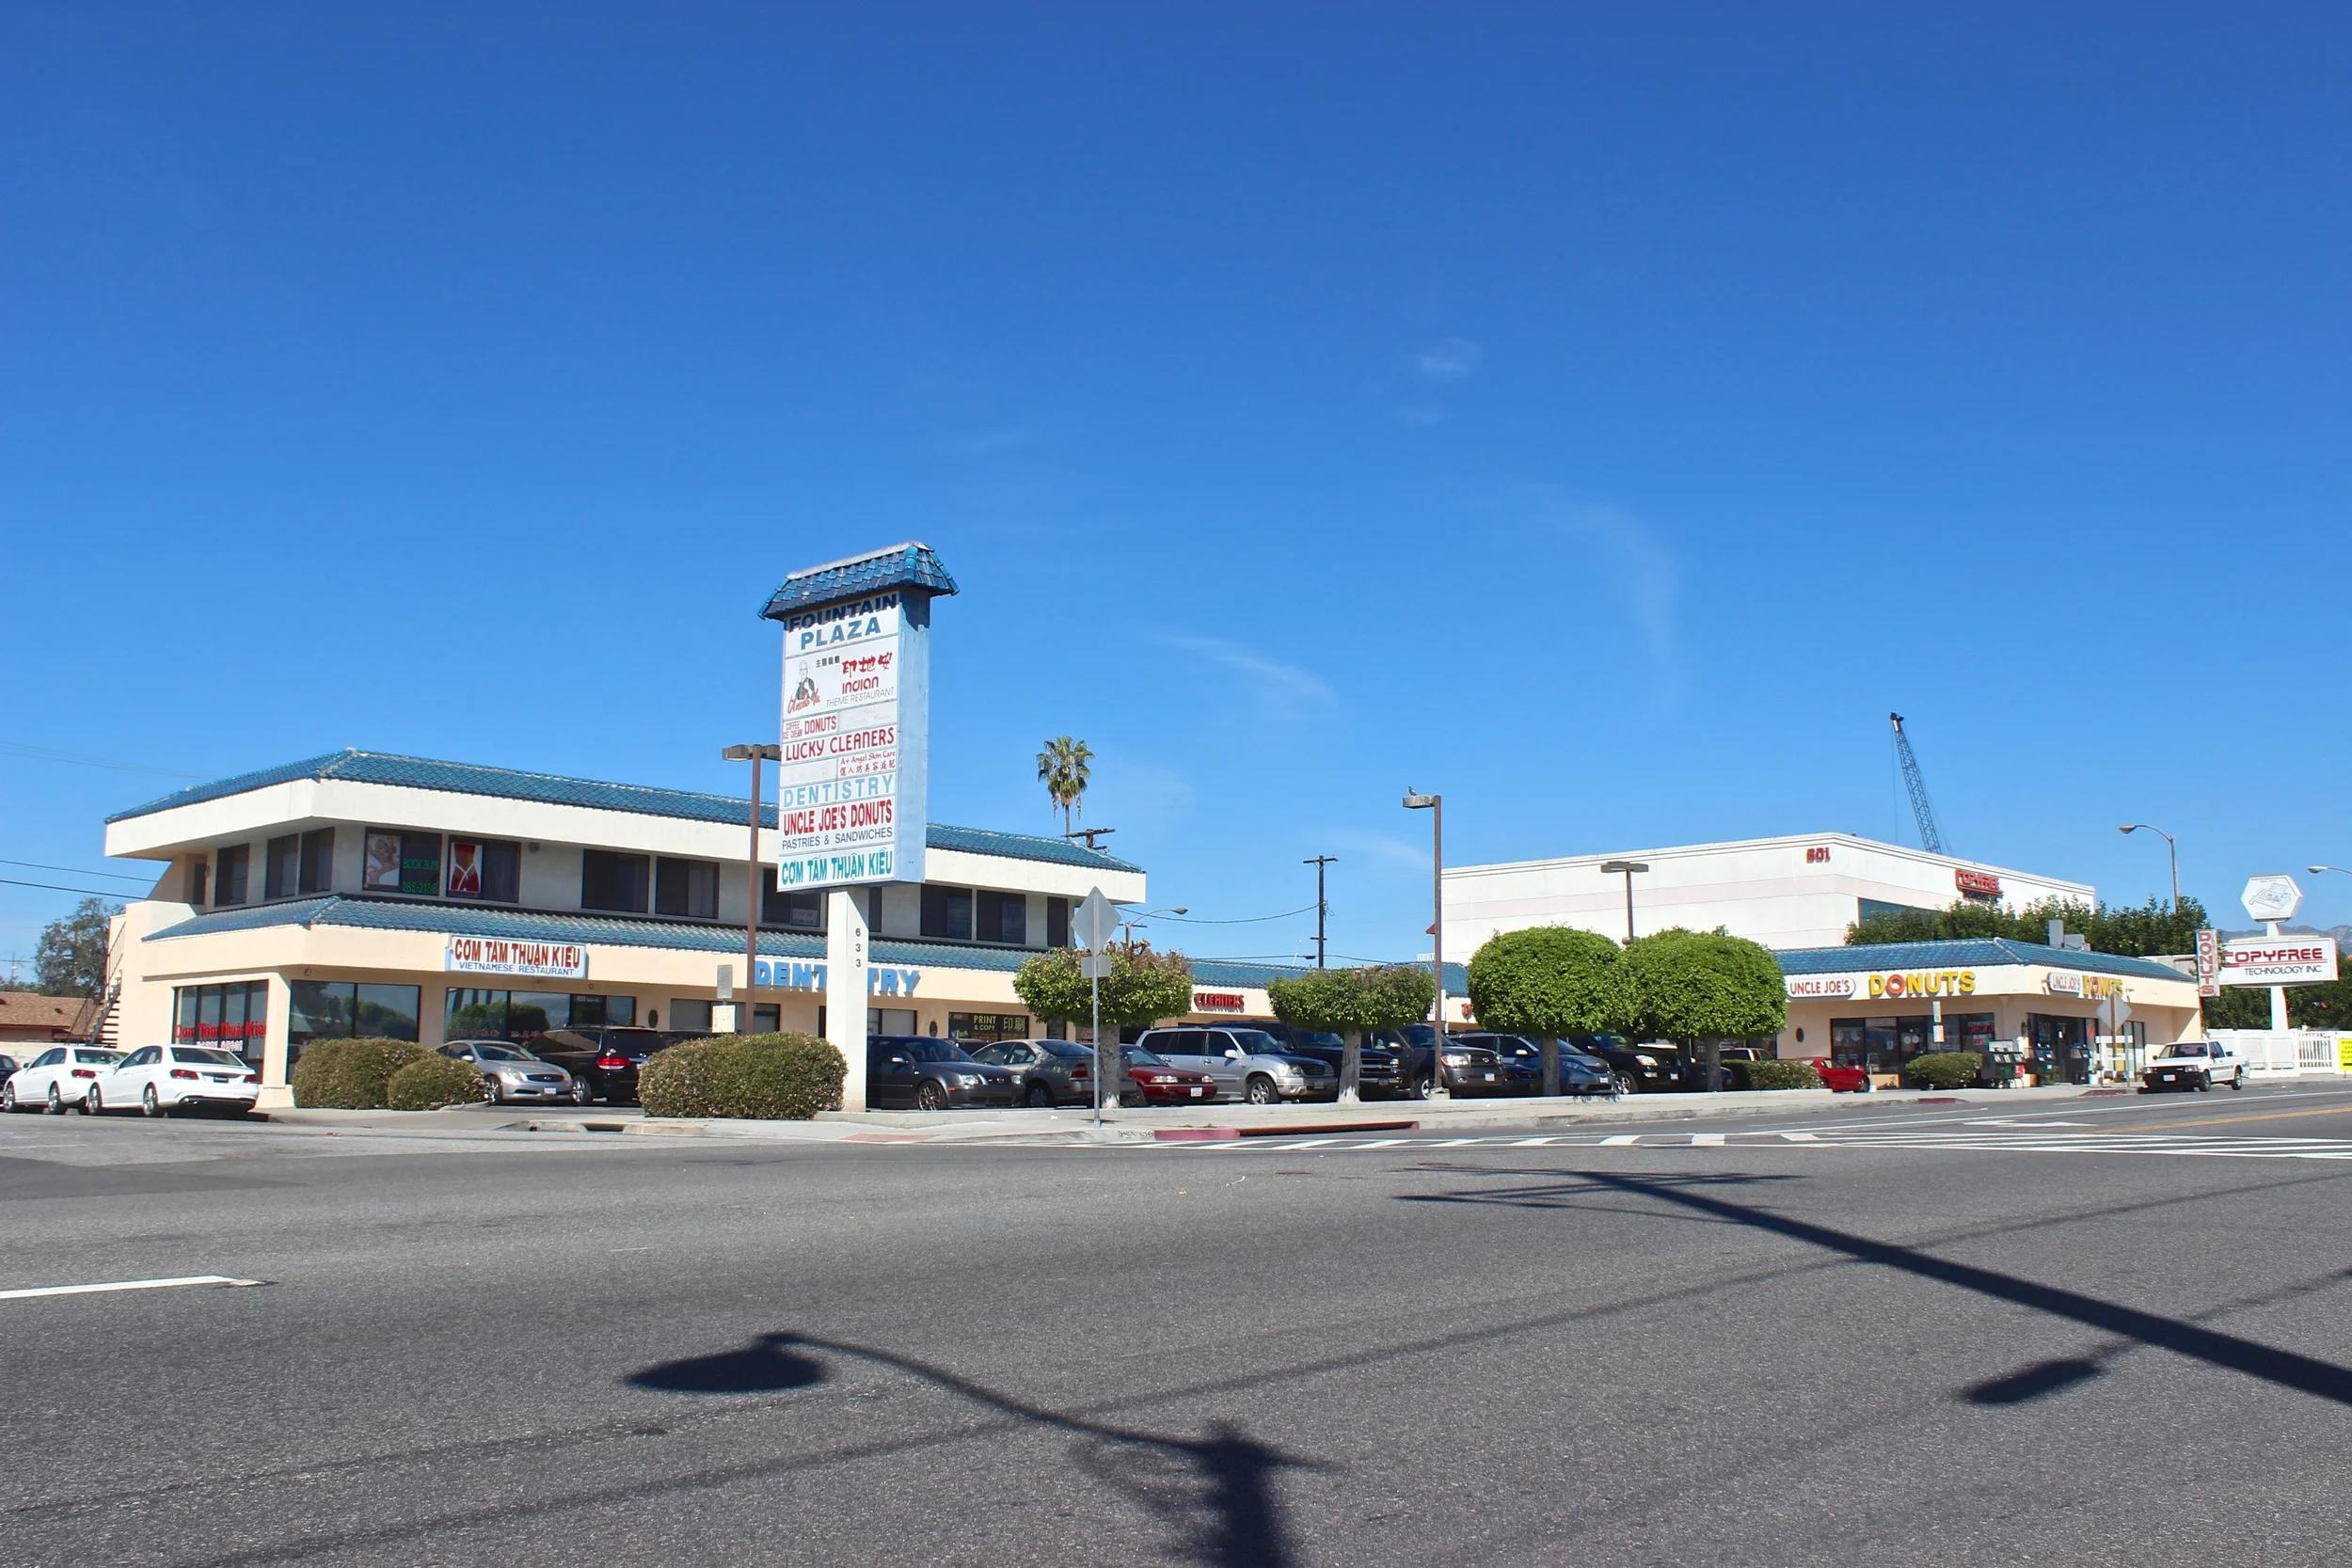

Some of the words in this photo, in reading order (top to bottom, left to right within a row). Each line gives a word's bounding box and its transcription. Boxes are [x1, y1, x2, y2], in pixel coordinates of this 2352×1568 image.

[788, 594, 898, 632] FOUNTAIN
[801, 617, 882, 650] PLAZA
[826, 696, 849, 707] THEME
[850, 687, 895, 703] RESTAURANT
[804, 715, 836, 735] DONUTS
[786, 739, 825, 761] LUCKY
[830, 727, 895, 753] CLEANERS
[851, 753, 867, 764] Angel
[784, 774, 894, 807] DENTISTRY
[784, 810, 815, 836] UNCLE
[818, 805, 847, 832] JOE'S
[850, 799, 892, 828] DONUTS
[782, 835, 820, 850] PASTRIES
[824, 834, 830, 845] &
[834, 827, 893, 844] SANDWICHES
[459, 961, 515, 973] VIETNAMESE
[518, 965, 575, 976] RESTAURANT
[2198, 932, 2215, 995] DONUTS
[2244, 965, 2304, 976] TECHNOLOGY
[2305, 964, 2324, 974] INC.
[1789, 981, 1821, 995] UNCLE
[1823, 978, 1851, 994] JOE'S
[1868, 971, 1977, 996] DONUTS
[1194, 992, 1245, 1008] CLEANERS
[973, 1015, 997, 1024] PRINT
[1003, 1017, 1025, 1032] 印刷
